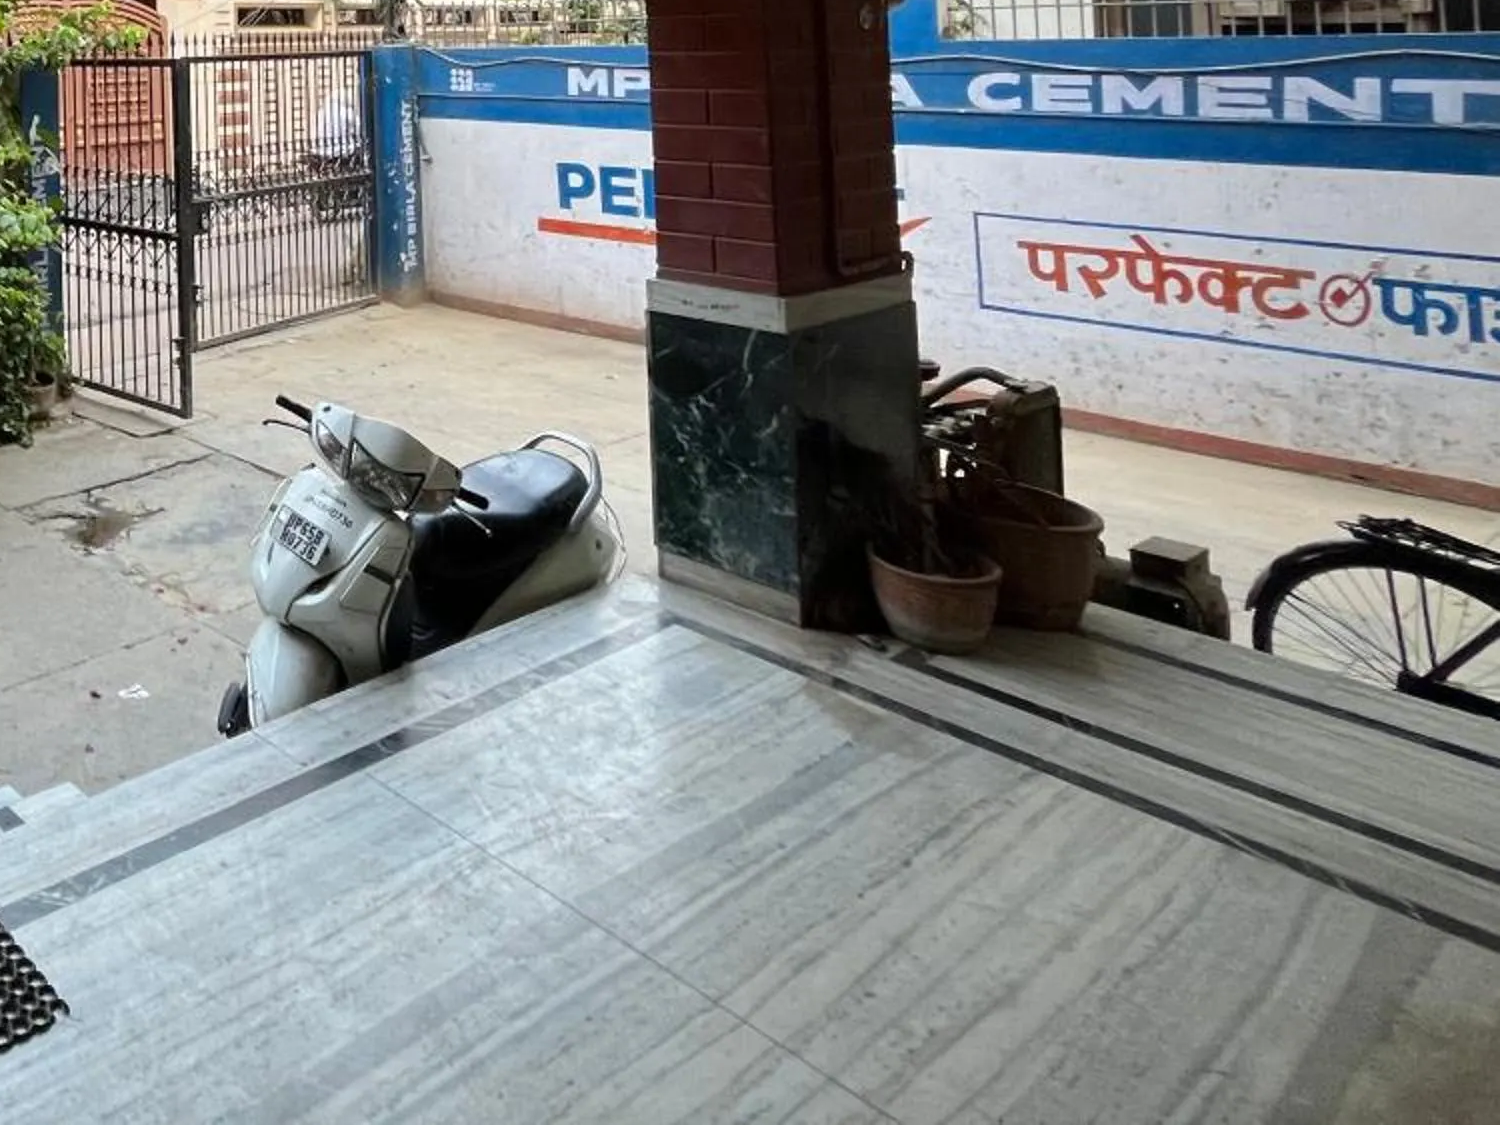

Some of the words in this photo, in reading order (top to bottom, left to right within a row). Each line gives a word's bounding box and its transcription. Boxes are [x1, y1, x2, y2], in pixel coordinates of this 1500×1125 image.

[967, 73, 1500, 124] CEMENT
[401, 99, 414, 176] CEMENT
[405, 177, 417, 235] BIRLA
[1017, 234, 1316, 320] परफेक्ट
[1372, 277, 1500, 344] फा
